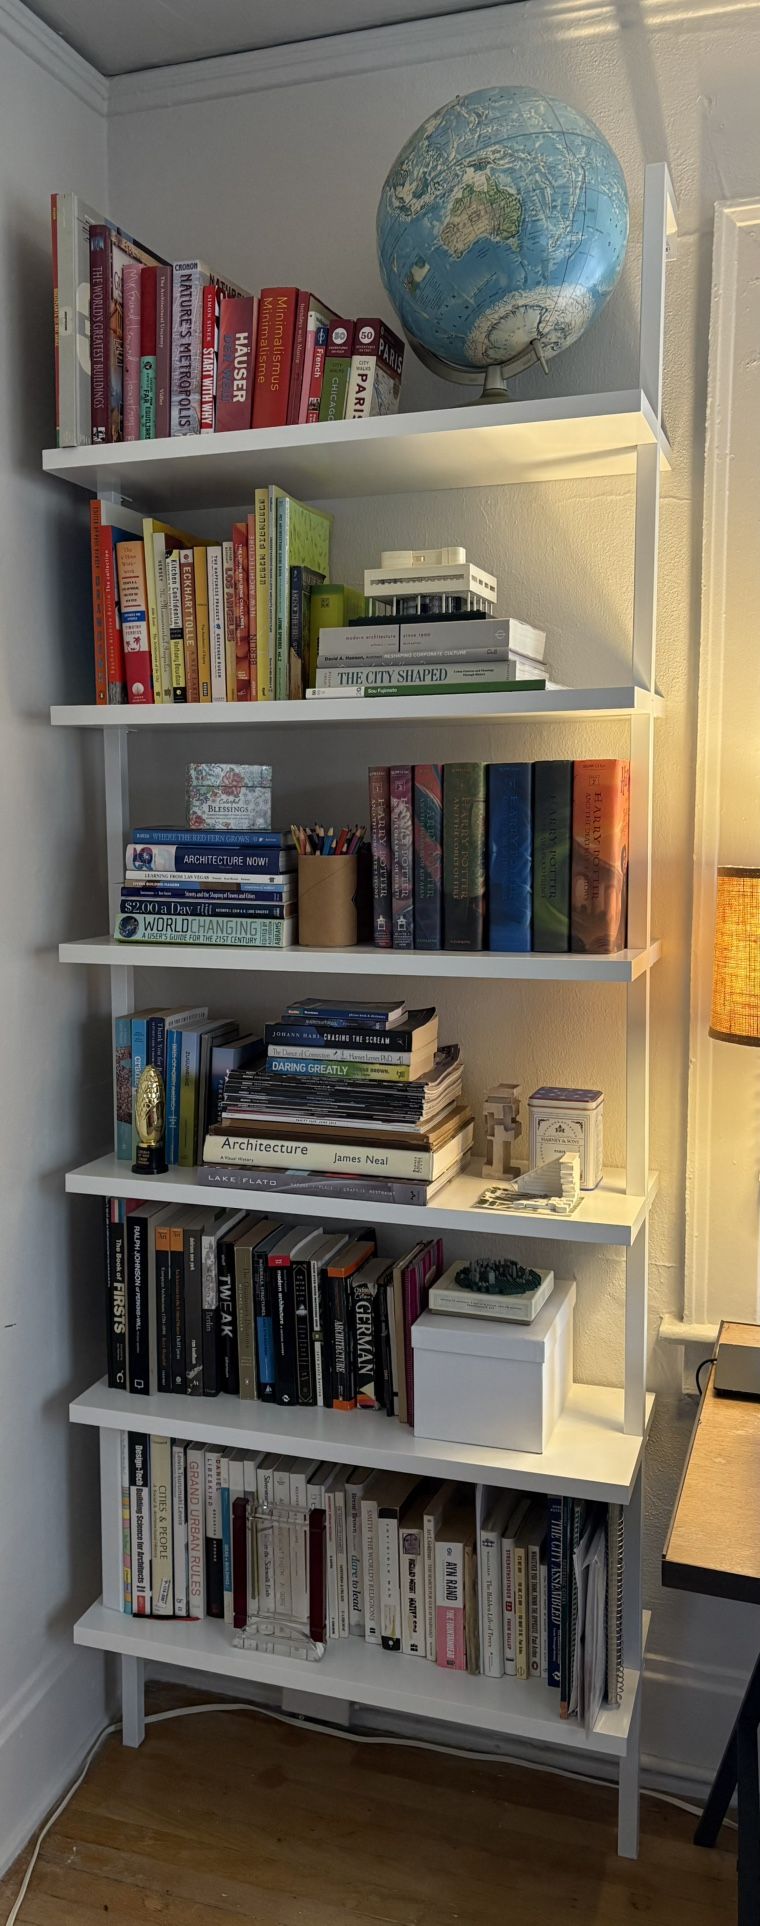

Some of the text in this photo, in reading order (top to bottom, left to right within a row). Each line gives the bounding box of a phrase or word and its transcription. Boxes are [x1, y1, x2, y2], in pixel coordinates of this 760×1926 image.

[174, 261, 198, 272] CRONON
[92, 266, 105, 409] THE WORLD'S GREATEST BUILDINGS
[257, 297, 273, 384] Minimalisme
[270, 296, 288, 391] Minimalismus
[360, 331, 373, 340] 50
[178, 273, 193, 428] NATURE'S METROPOLIS
[202, 347, 215, 376] START
[314, 348, 324, 378] French
[378, 338, 403, 374] PARIS
[232, 332, 249, 403] HÄUSER
[201, 377, 214, 401] WITH
[201, 402, 214, 424] WHY
[170, 559, 180, 585] Kitchen
[171, 586, 181, 629] Confidential
[183, 566, 195, 647] ECKHART TOLLE
[225, 567, 235, 642] LOS ANGELES
[249, 634, 257, 666] BERLIN
[337, 671, 363, 686] THE
[365, 669, 394, 684] CITY
[396, 668, 448, 683] SHAPED
[153, 833, 250, 843] WHERE THE RED FERN GROWS
[377, 799, 388, 897] HARRY POTTER
[460, 797, 470, 899] HARRY POTTER
[591, 791, 602, 901] HARRY POTTER
[183, 855, 269, 866] ARCHITECTURE NOW!
[401, 850, 409, 897] POTTER
[549, 850, 558, 898] POTTER
[125, 902, 193, 916] $2.00 a Day
[143, 916, 258, 937] WORLDCHANGING
[169, 933, 187, 941] GUIDE
[214, 935, 229, 943] 21ST
[230, 936, 258, 944] CENTURY
[274, 921, 282, 945] ABRAMS
[156, 1022, 164, 1042] Thank
[272, 1031, 300, 1039] JOHANN
[323, 1033, 350, 1042] CHASING
[352, 1034, 363, 1043] THE
[365, 1036, 390, 1045] SCREAM
[156, 1043, 164, 1055] You
[272, 1048, 281, 1056] The
[299, 1049, 304, 1057] of
[272, 1061, 349, 1076] DARING GREATLY
[221, 1137, 309, 1156] Architecture
[333, 1152, 389, 1166] James Neal
[208, 1175, 277, 1186] LAKE FLATO
[133, 1225, 141, 1251] RALPH
[114, 1253, 122, 1273] Book
[115, 1273, 122, 1281] of
[134, 1250, 142, 1287] JOHNSON
[113, 1282, 125, 1334] FIRSTS
[219, 1273, 233, 1339] TWEAK
[205, 1311, 213, 1332] Berlin
[334, 1320, 346, 1374] ARCHITECTURE
[355, 1301, 374, 1376] GERMAN
[158, 1485, 168, 1512] CITIES
[134, 1444, 146, 1584] Design-Tech Building Science for Architects
[159, 1526, 168, 1560] PEOPLE
[189, 1461, 201, 1597] GRAND URBAN RULES
[551, 1520, 562, 1541] THE
[551, 1541, 562, 1563] CITY
[351, 1554, 360, 1579] dare
[367, 1551, 375, 1582] WORLD'S
[351, 1579, 360, 1590] to
[445, 1561, 458, 1601] AYN RAND
[551, 1564, 562, 1625] ASSEMBLED
[352, 1590, 362, 1612] lead
[368, 1583, 376, 1621] RELIGIONS
[446, 1609, 455, 1659] THE FOUNTAINHEAD
